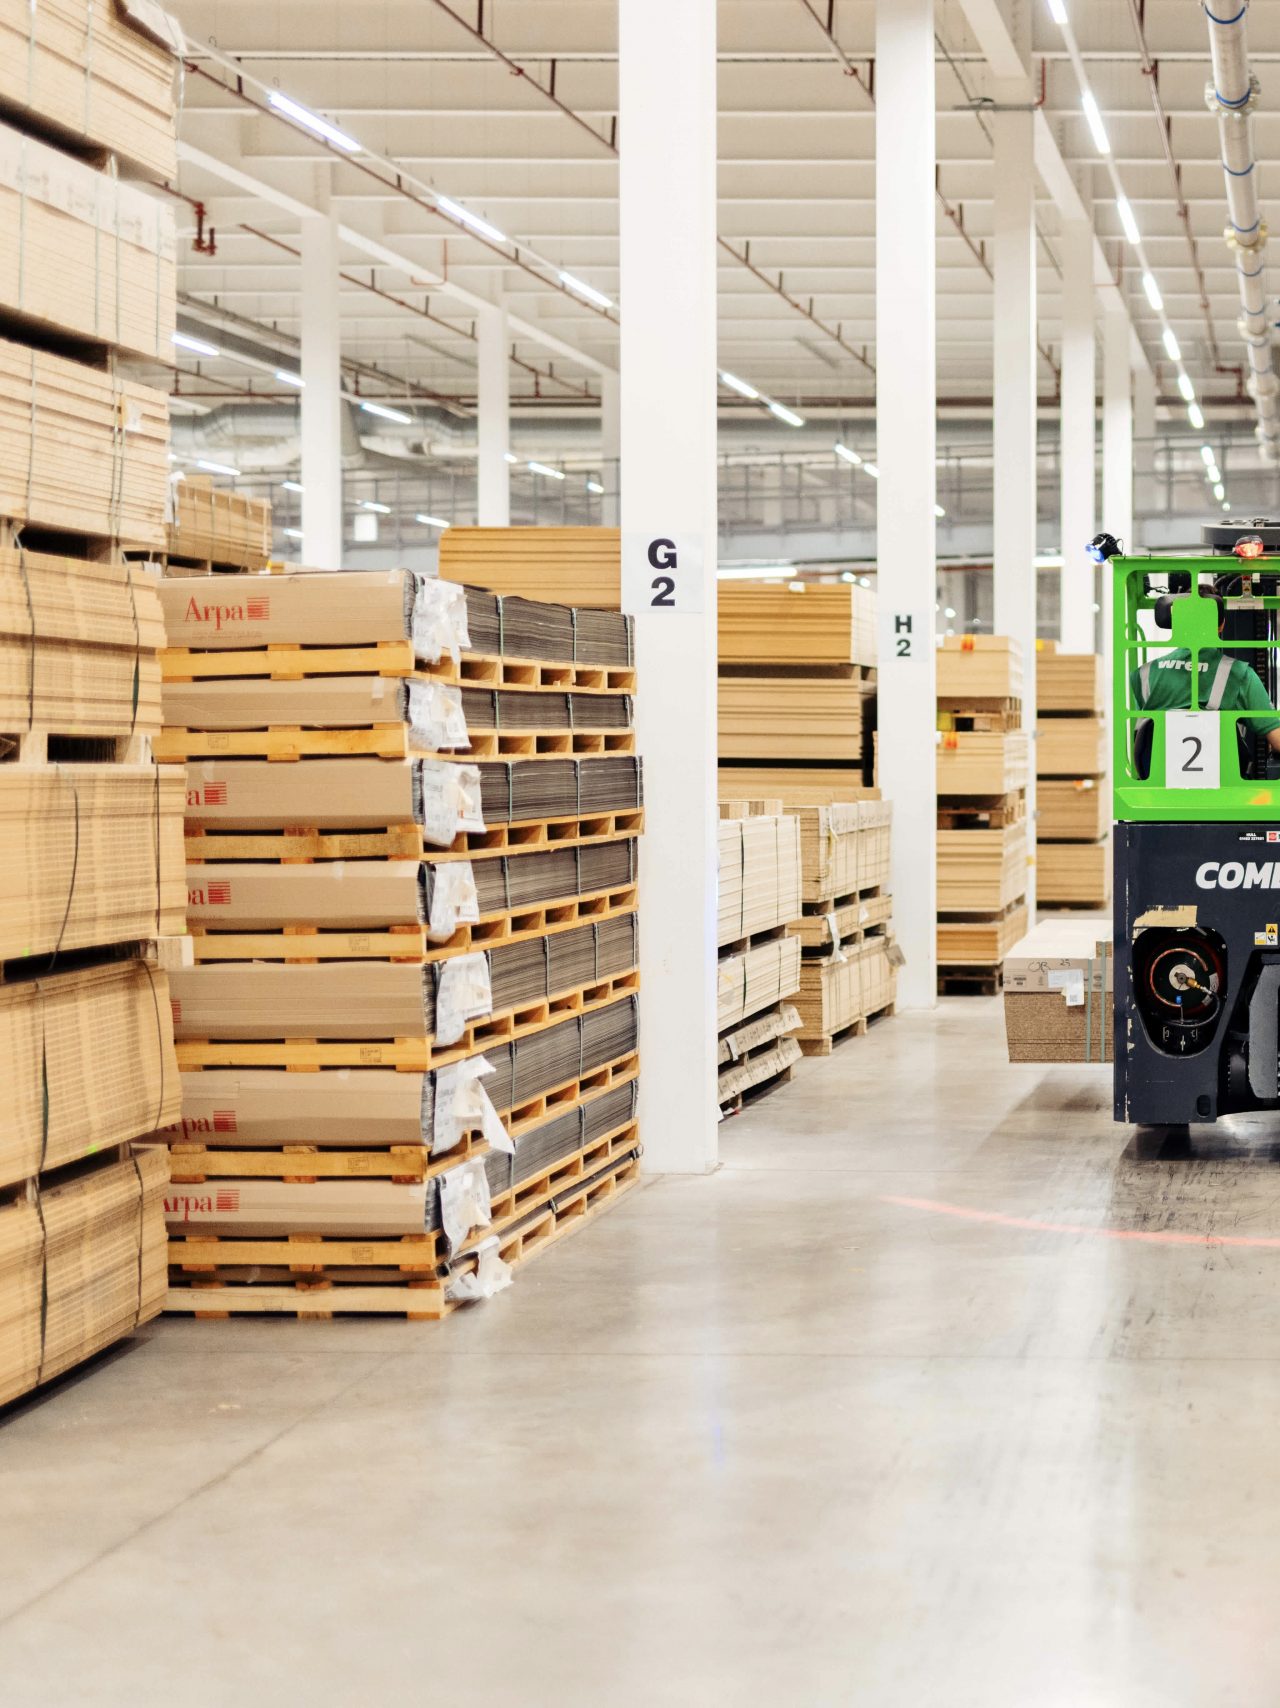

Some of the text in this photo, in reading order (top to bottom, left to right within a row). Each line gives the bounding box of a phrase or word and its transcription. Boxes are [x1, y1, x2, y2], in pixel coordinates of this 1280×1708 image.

[647, 538, 678, 570] G
[650, 576, 676, 607] 2
[184, 595, 244, 631] Arpa
[894, 615, 913, 633] H
[896, 639, 912, 657] 2
[1158, 659, 1209, 673] wren
[1181, 736, 1204, 772] 2
